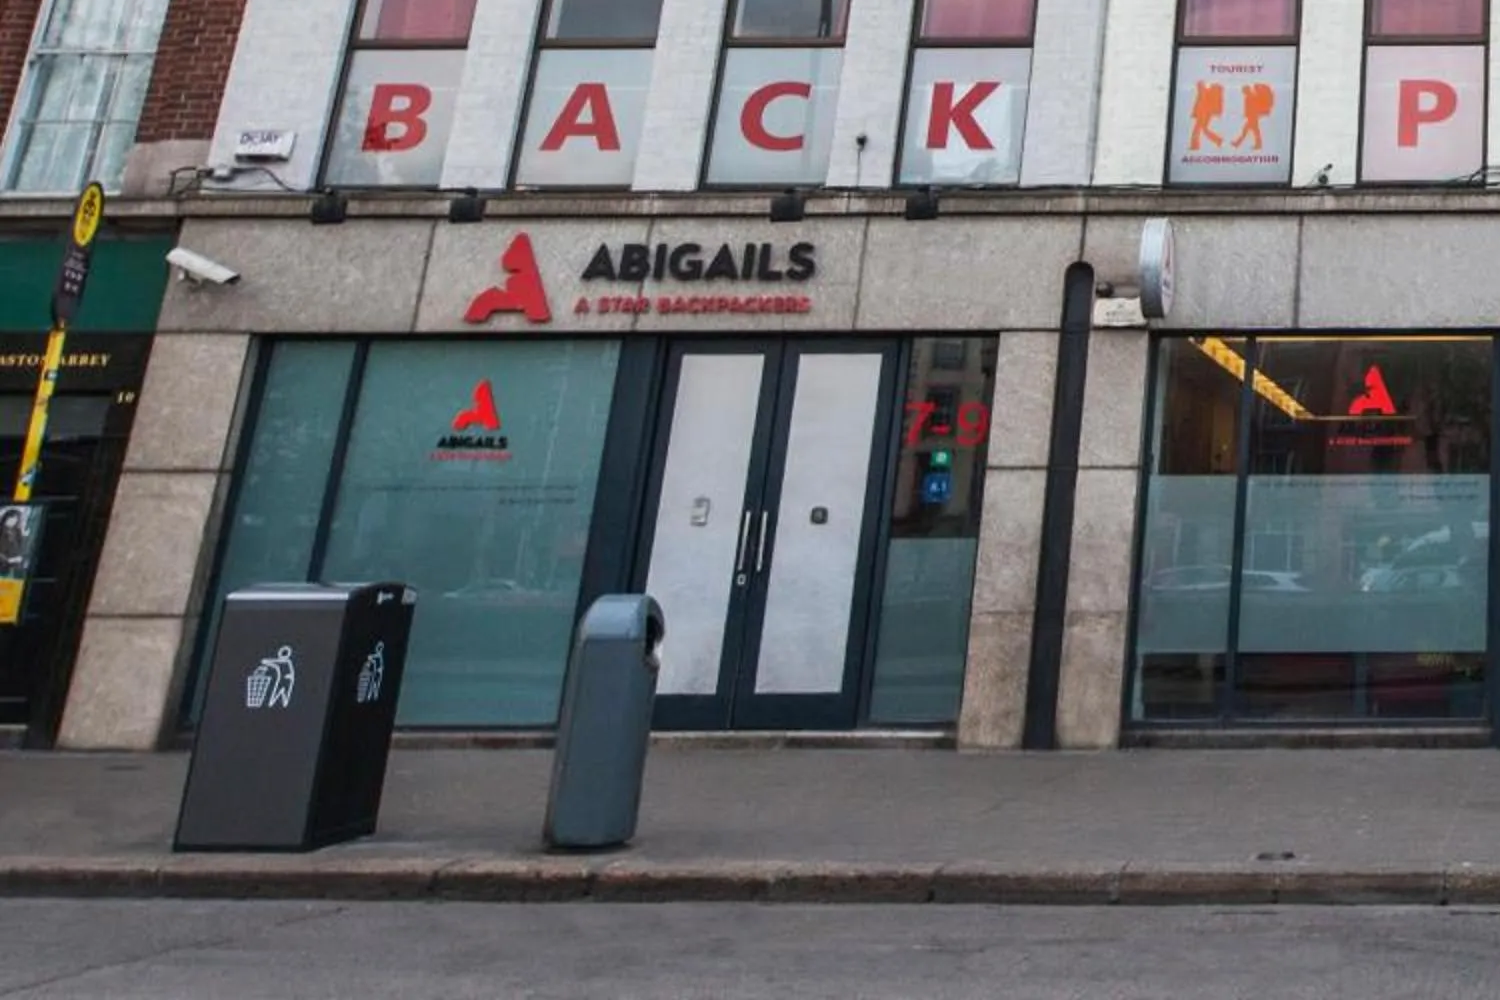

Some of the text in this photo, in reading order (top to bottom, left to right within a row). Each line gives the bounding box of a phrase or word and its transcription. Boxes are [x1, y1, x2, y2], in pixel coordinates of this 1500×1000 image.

[1211, 64, 1263, 73] TOURIST
[580, 242, 816, 282] ABIGAILS
[573, 297, 812, 315] A STAR BACKPACKERS
[905, 400, 990, 447] 7-9
[437, 436, 508, 448] ABIGAILS
